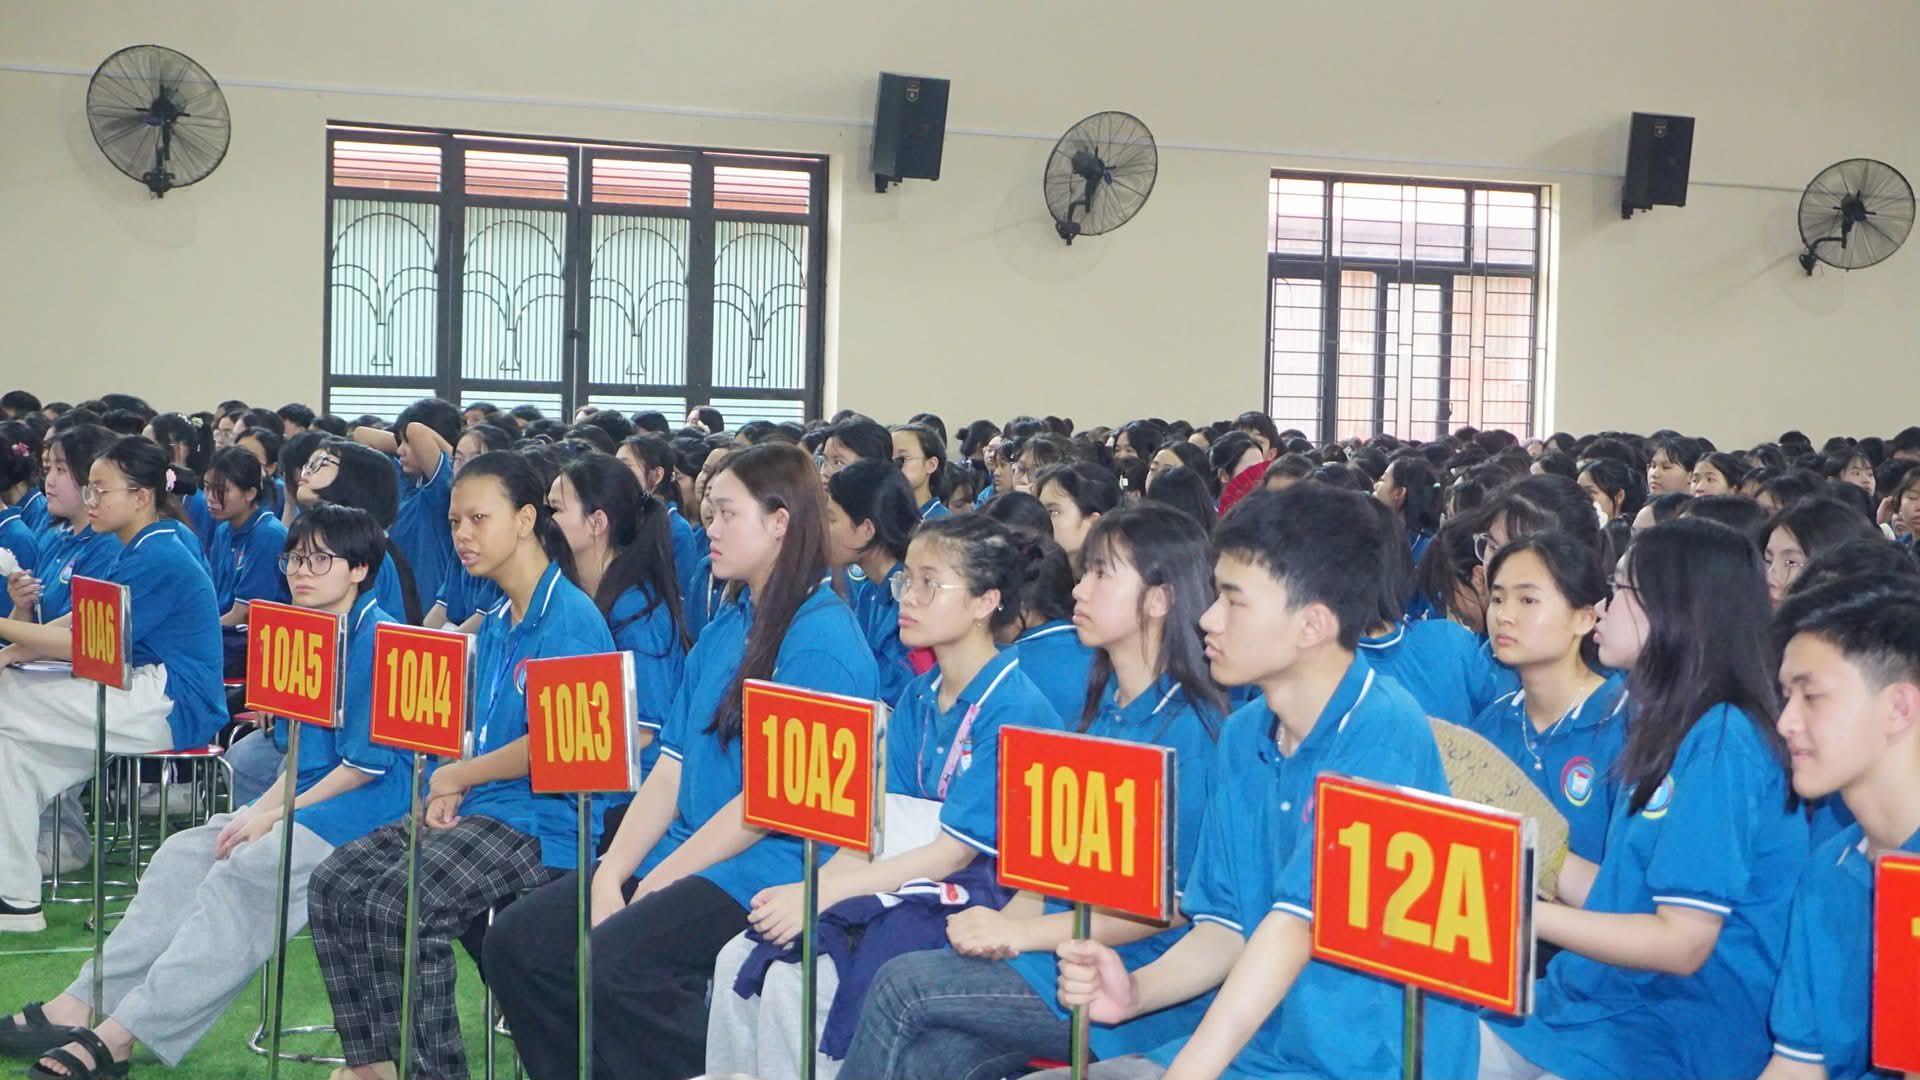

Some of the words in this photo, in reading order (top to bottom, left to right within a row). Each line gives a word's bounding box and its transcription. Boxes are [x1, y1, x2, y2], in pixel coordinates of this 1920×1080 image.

[79, 599, 115, 663] 10A6
[259, 624, 322, 699] 10A5
[387, 647, 451, 727] 10A4
[538, 681, 612, 763] 10A3
[762, 714, 857, 817] 10A2
[1024, 763, 1136, 877] 10A1
[1338, 821, 1493, 964] 12A
